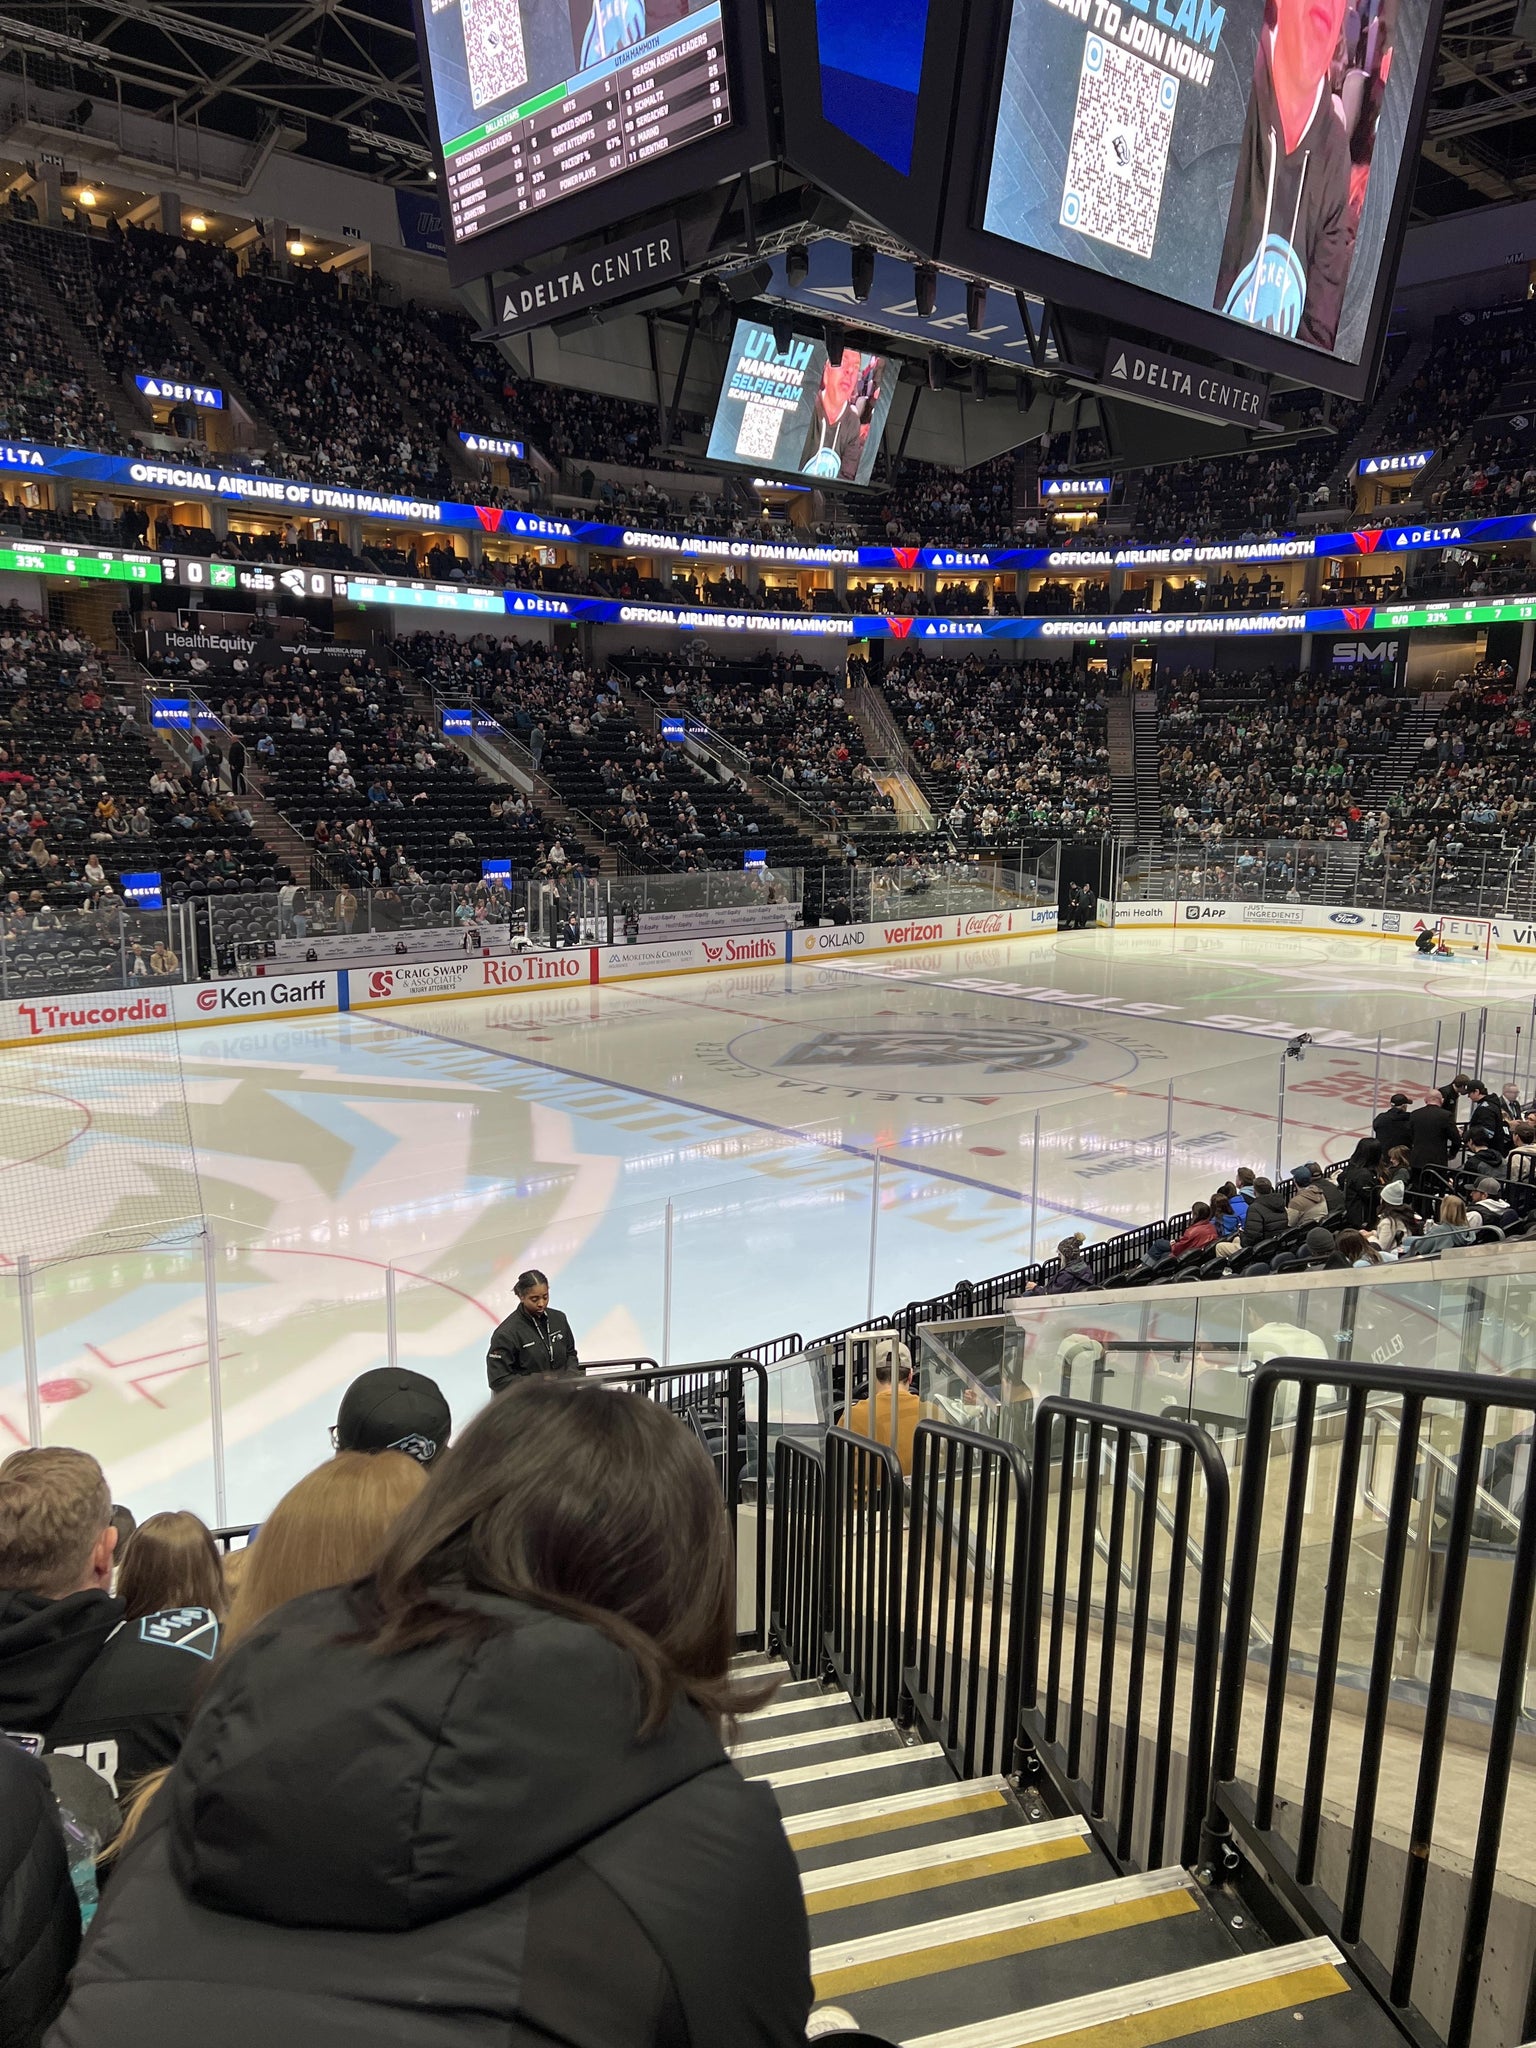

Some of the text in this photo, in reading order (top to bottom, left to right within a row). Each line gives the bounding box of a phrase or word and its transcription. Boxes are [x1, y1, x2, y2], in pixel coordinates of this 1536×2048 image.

[1156, 0, 1227, 53] CAM
[614, 36, 660, 67] UTAH MAMMOTH
[1093, 0, 1215, 87] TO JOIN NOW!
[632, 32, 708, 80] SEASON ASSIST LEADERS
[632, 78, 655, 97] KELLER
[707, 47, 717, 61] 30
[708, 64, 718, 78] 25
[530, 81, 610, 129] 7 HITS 5
[636, 80, 720, 128] SERGACHEV 25
[551, 118, 575, 139] BLOCKED
[574, 110, 593, 127] SHOTS
[606, 100, 613, 111] 4
[533, 118, 617, 166] 13 SHOT ATTEMPTS 20
[629, 113, 722, 163] 11 GUENTHER 17
[630, 136, 636, 147] 6
[638, 125, 660, 143] MARINO
[455, 150, 474, 167] SEASON
[490, 132, 512, 151] LEADERS
[532, 170, 546, 185] 33%
[606, 136, 621, 151] 67%
[535, 155, 621, 201] 0/0 POWER PLAYS 0/1
[520, 238, 672, 313] DELTA CENTER
[744, 330, 815, 371] UTAH
[736, 356, 805, 386] MAMMOTH
[730, 373, 804, 402] SELFIE CAM
[1132, 359, 1260, 415] DELTA CENTER
[727, 388, 750, 401] SCAN
[749, 391, 762, 403] TO
[778, 399, 799, 412] NOW!
[478, 438, 520, 456] DELTA
[1380, 455, 1426, 470] DELTA
[130, 464, 441, 520] OFFICIAL AIRLINE OF UTAH MAMMOTH
[1062, 481, 1103, 491] DELTA
[529, 519, 571, 535] DELTA
[1412, 527, 1461, 543] DELTA
[623, 531, 858, 563] OFFICIAL AIRLINE OF UTAH MAMMOTH
[1049, 540, 1315, 565] OFFICIAL AIRLINE OF UTAH MAMMOTH
[16, 555, 146, 578] 33% 6 7 13
[946, 554, 989, 565] DELTA
[188, 563, 324, 593] 0 4:25 0
[334, 584, 347, 595] 10
[527, 599, 568, 613] DELTA
[1392, 607, 1532, 625] 0/0 33% 6 7 13
[620, 607, 853, 632] OFFICIAL AIRLINE OF UTAH MAMMOTH
[939, 623, 983, 633] DELTA
[1042, 615, 1306, 636] OFFICIAL AIRLINE OF UTAH MAMMOTH
[165, 632, 257, 653] HealthEquity
[163, 710, 188, 718] DELTA
[1031, 909, 1058, 925] Layton
[1133, 907, 1163, 917] Health
[1247, 911, 1300, 919] INGREDIENTS
[1335, 913, 1359, 924] Ford
[819, 931, 865, 948] OKLAND
[884, 921, 942, 944] verizon
[1435, 920, 1500, 937] DELTA
[1513, 925, 1536, 944] vi
[622, 953, 655, 961] MORETON
[661, 950, 693, 959] COMPANY
[725, 938, 776, 961] Smith's
[396, 964, 469, 979] CRAIG SWAPP
[402, 974, 462, 988] & ASSOCIATES
[221, 980, 326, 1009] Ken Garff
[409, 983, 456, 994] INJURY ATTORNEYS
[43, 998, 167, 1028] Trucordia
[1072, 1027, 1168, 1060] CENTER
[696, 1041, 944, 1104] DELTA CENTER
[1287, 1070, 1389, 1097] SEAT
[1371, 1334, 1406, 1364] KELLER
[150, 1610, 203, 1638] UTAH
